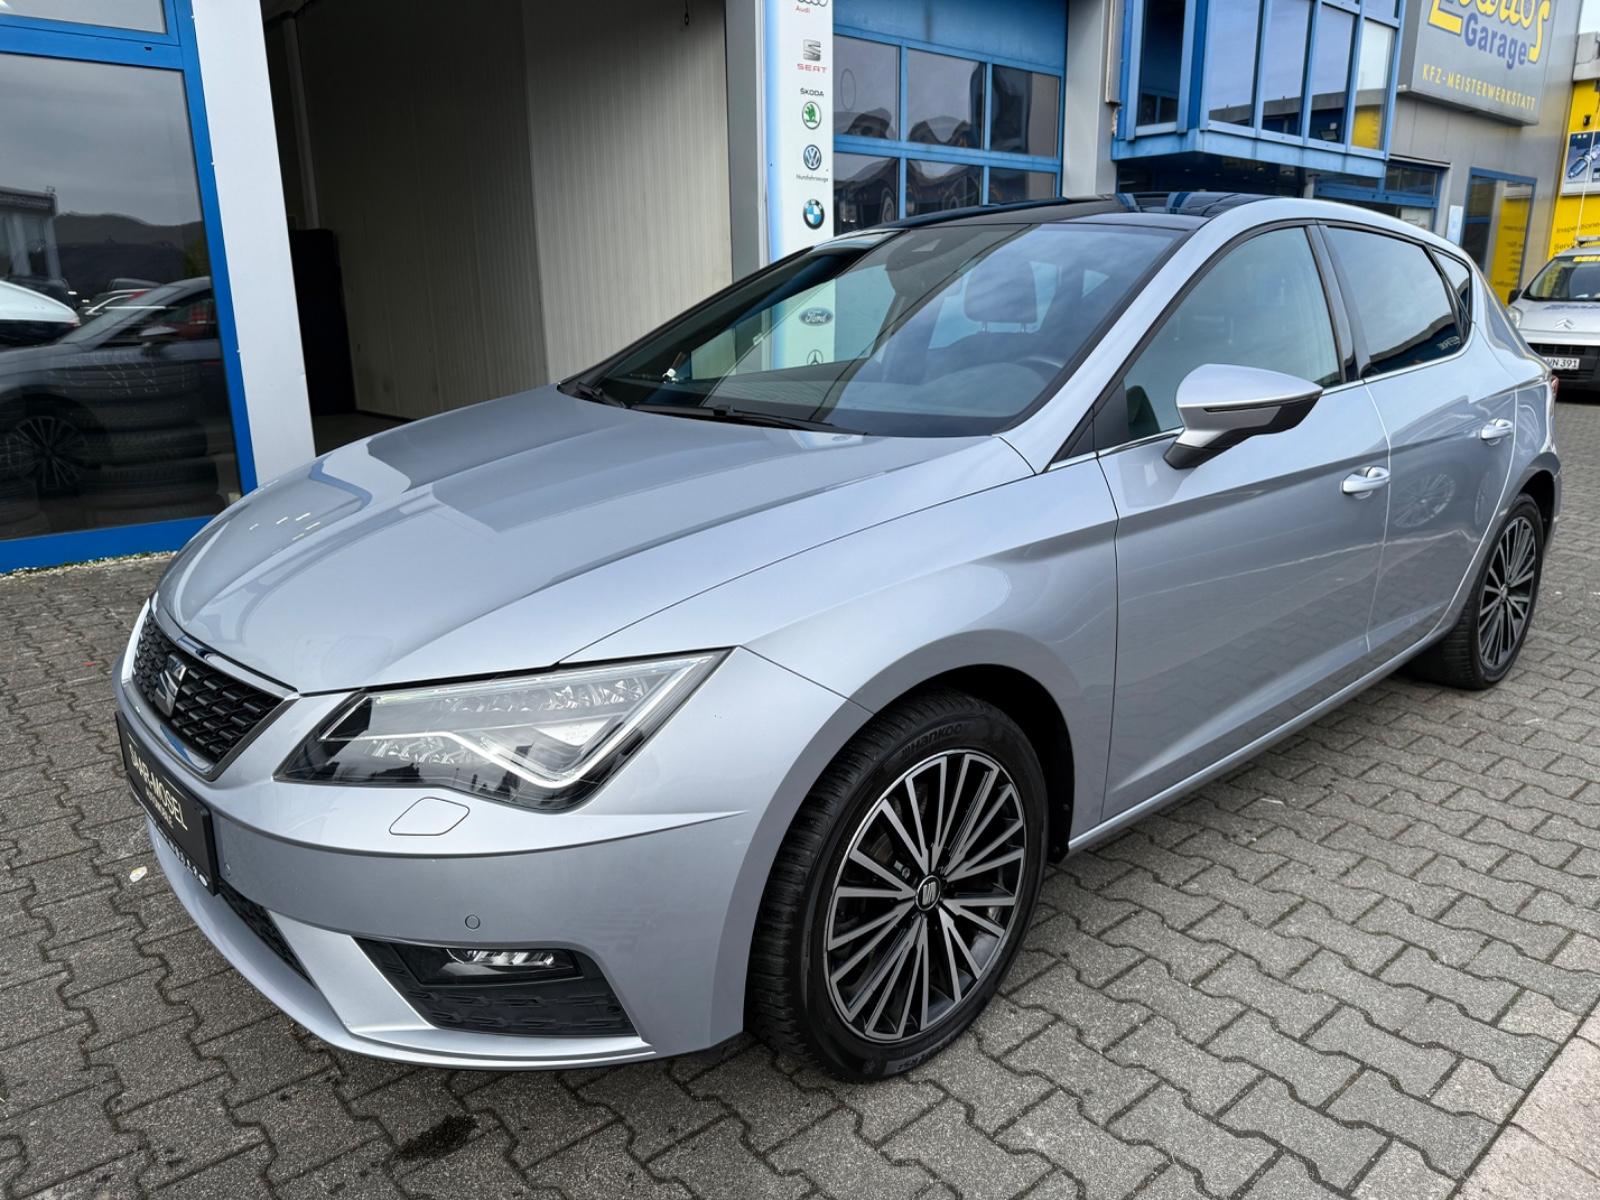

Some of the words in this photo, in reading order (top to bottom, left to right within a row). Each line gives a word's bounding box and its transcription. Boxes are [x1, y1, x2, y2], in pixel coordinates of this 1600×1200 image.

[795, 5, 811, 14] Audi
[1464, 12, 1528, 70] Garage
[796, 63, 827, 73] SEAT
[805, 310, 830, 323] Ford
[1560, 359, 1577, 368] 391
